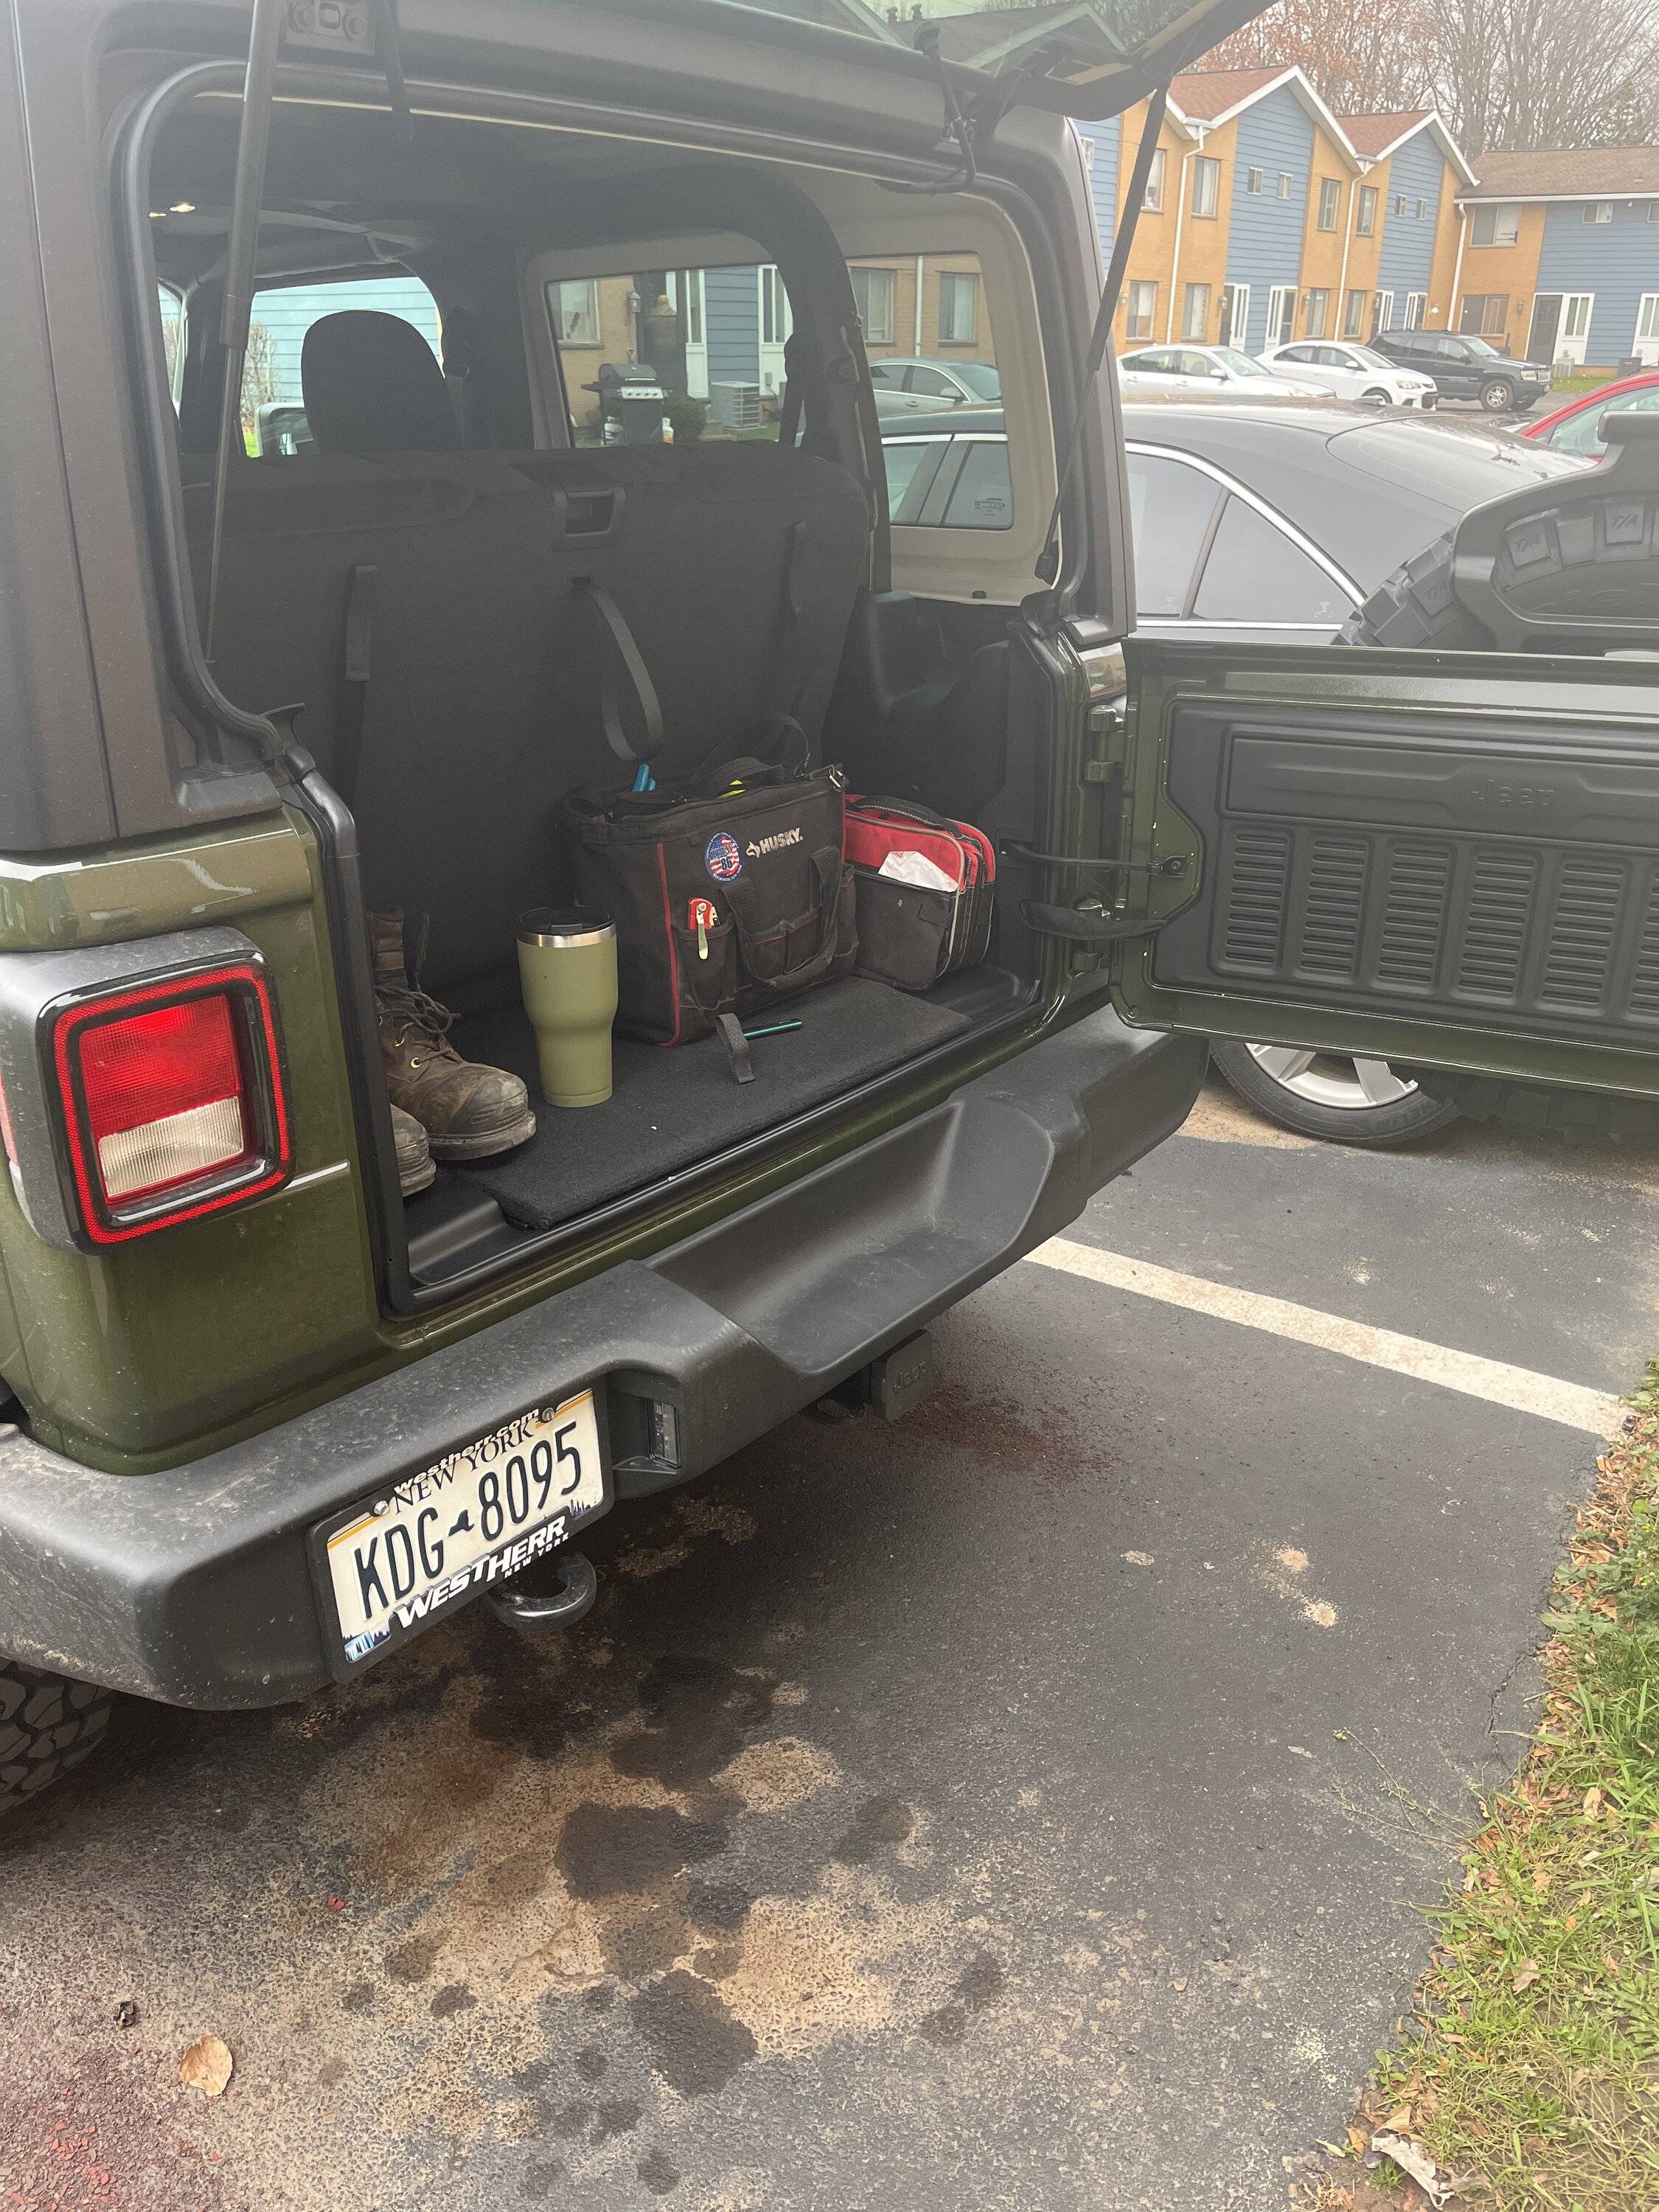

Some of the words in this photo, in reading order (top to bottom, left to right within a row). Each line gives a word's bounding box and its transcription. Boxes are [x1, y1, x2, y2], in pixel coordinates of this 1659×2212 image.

[720, 856, 733, 870] 86
[394, 1408, 540, 1495] westherr.com
[394, 1459, 458, 1515] NEW
[465, 1417, 535, 1472] YORK
[354, 1507, 444, 1620] KDG
[479, 1421, 581, 1542] 8095
[504, 1556, 532, 1579] NEW
[538, 1531, 570, 1557] YORK
[395, 1515, 566, 1629] WESTHERR
